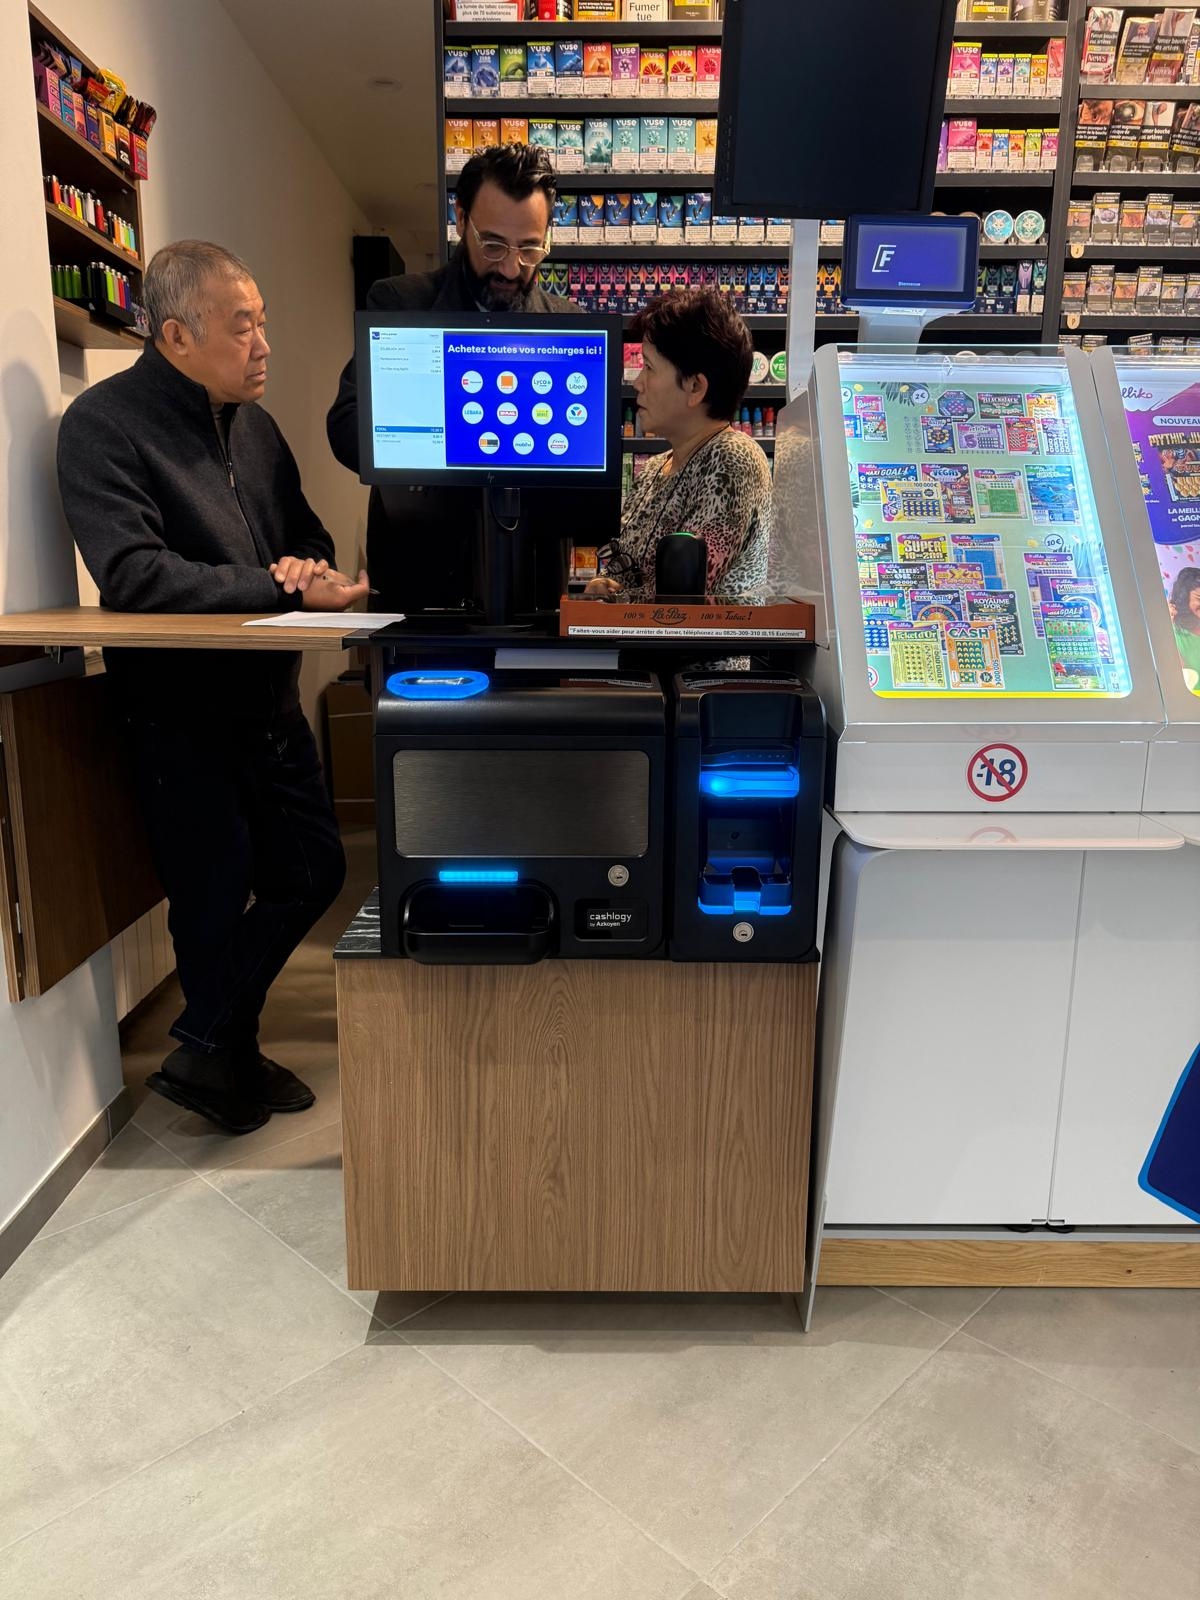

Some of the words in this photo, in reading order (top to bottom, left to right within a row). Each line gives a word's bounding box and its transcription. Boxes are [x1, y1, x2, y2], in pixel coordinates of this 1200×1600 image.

[629, 2, 660, 11] Fumer
[637, 12, 652, 20] tue
[1088, 54, 1106, 62] News
[448, 344, 486, 353] Achetez
[488, 345, 517, 353] toutes
[537, 345, 584, 356] recharges
[586, 346, 597, 354] ici
[888, 488, 898, 516] CASH
[904, 540, 942, 552] SUPER
[948, 628, 989, 638] CASH
[976, 758, 1016, 786] -18
[590, 912, 632, 922] cashlogy
